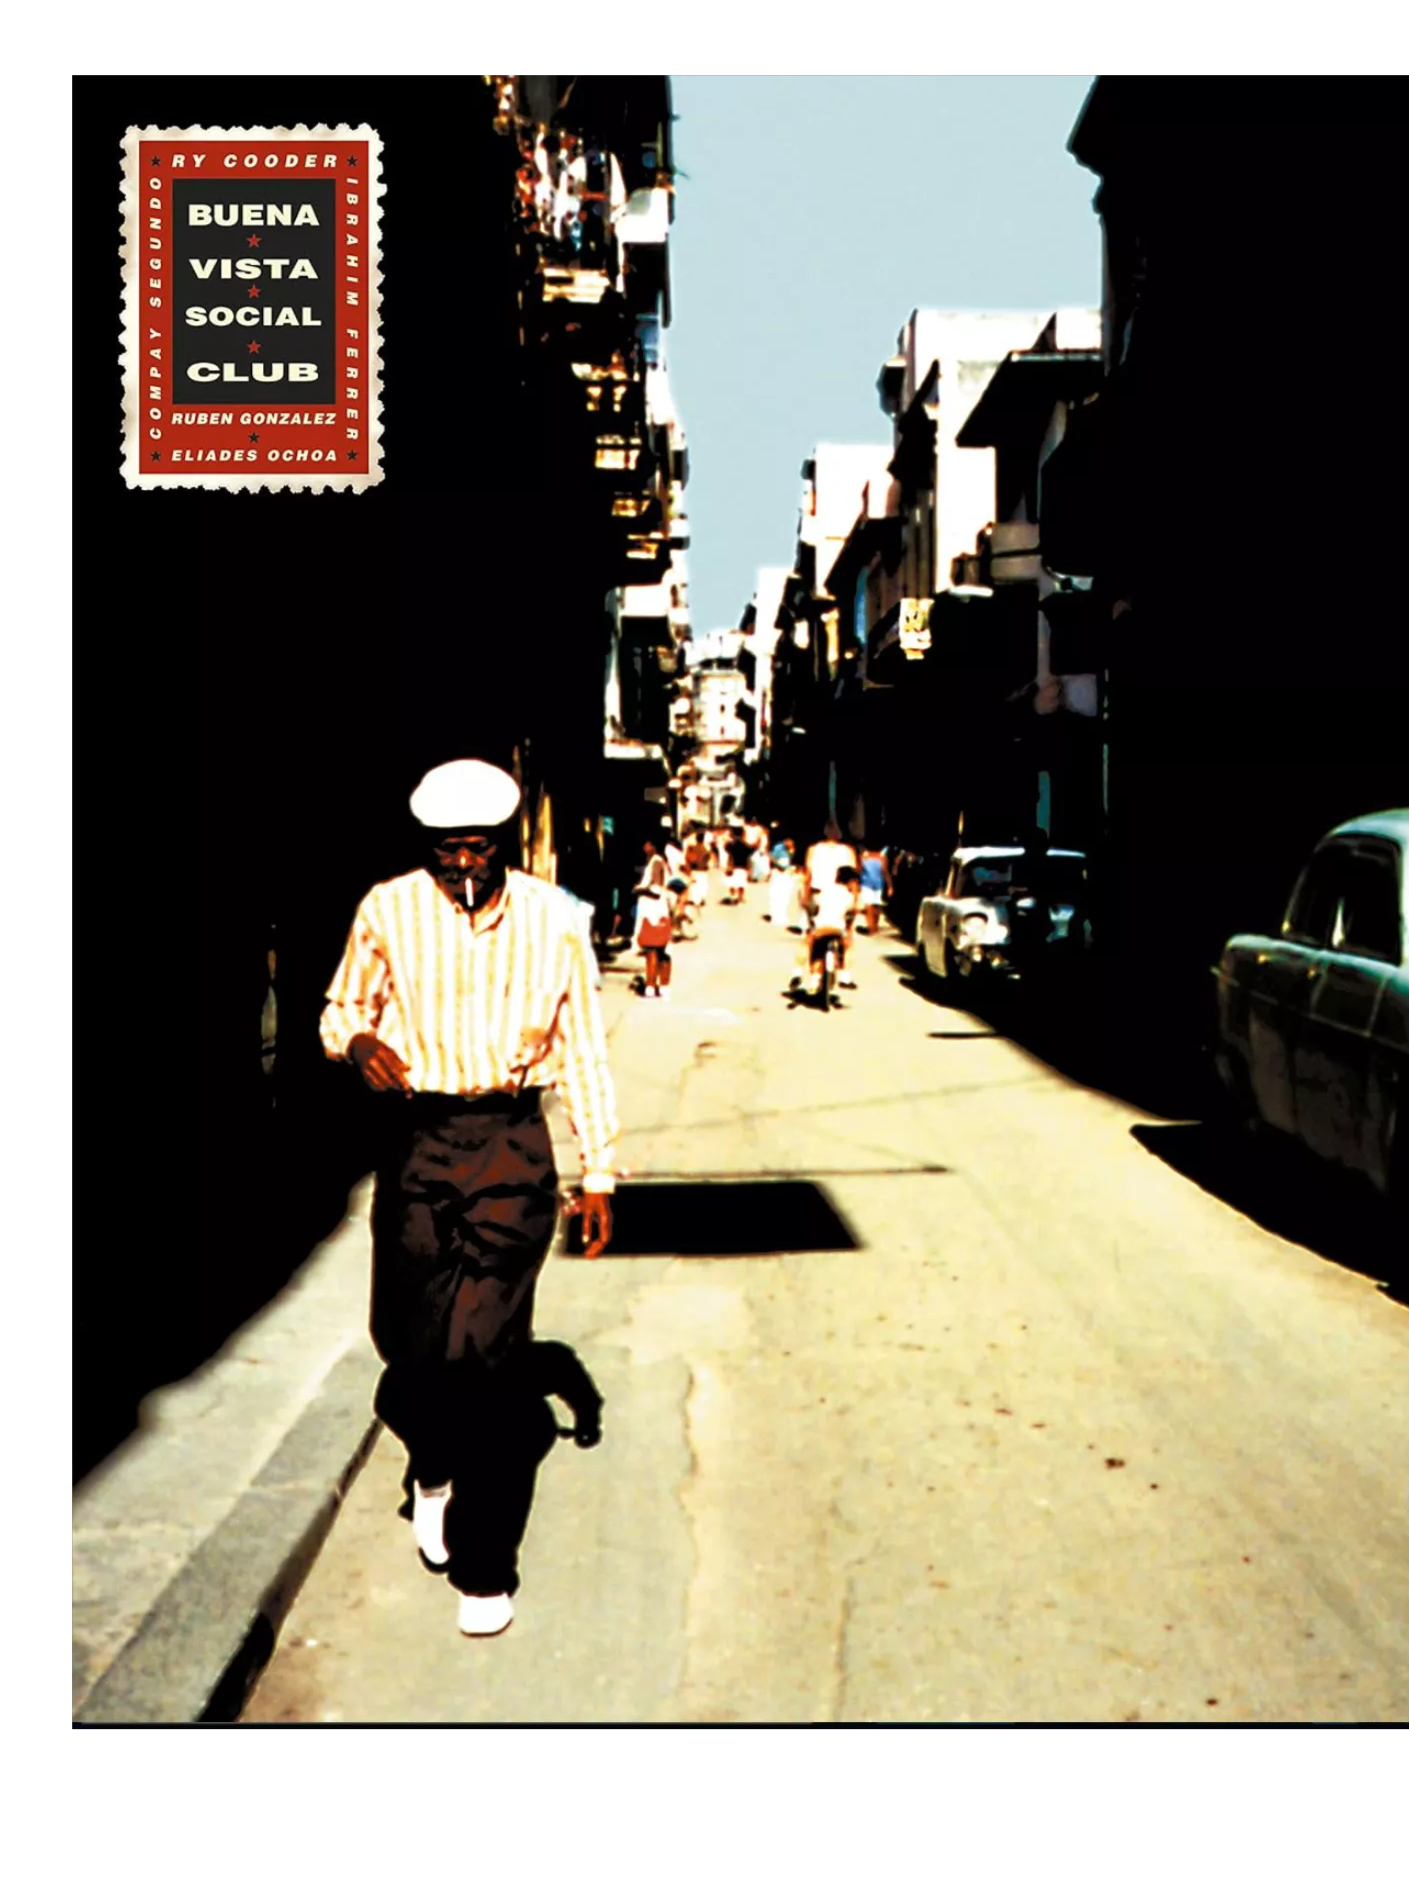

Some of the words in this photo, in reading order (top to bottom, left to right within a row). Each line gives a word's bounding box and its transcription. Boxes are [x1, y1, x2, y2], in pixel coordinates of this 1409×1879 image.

[171, 154, 206, 168] RY
[223, 153, 338, 168] COODER
[188, 203, 320, 227] BUENA
[149, 177, 162, 308] SEGUNDO
[346, 177, 359, 306] IBRAHIM
[188, 258, 319, 280] VISTA
[185, 306, 322, 327] SOCIAL
[149, 327, 162, 440] COMPAY
[186, 362, 319, 383] CLUB
[346, 328, 359, 440] FERRER
[171, 412, 234, 425] RUBEN
[239, 412, 337, 425] GONZALEZ
[171, 449, 258, 462] ELIADES
[267, 449, 337, 462] OCHOA
